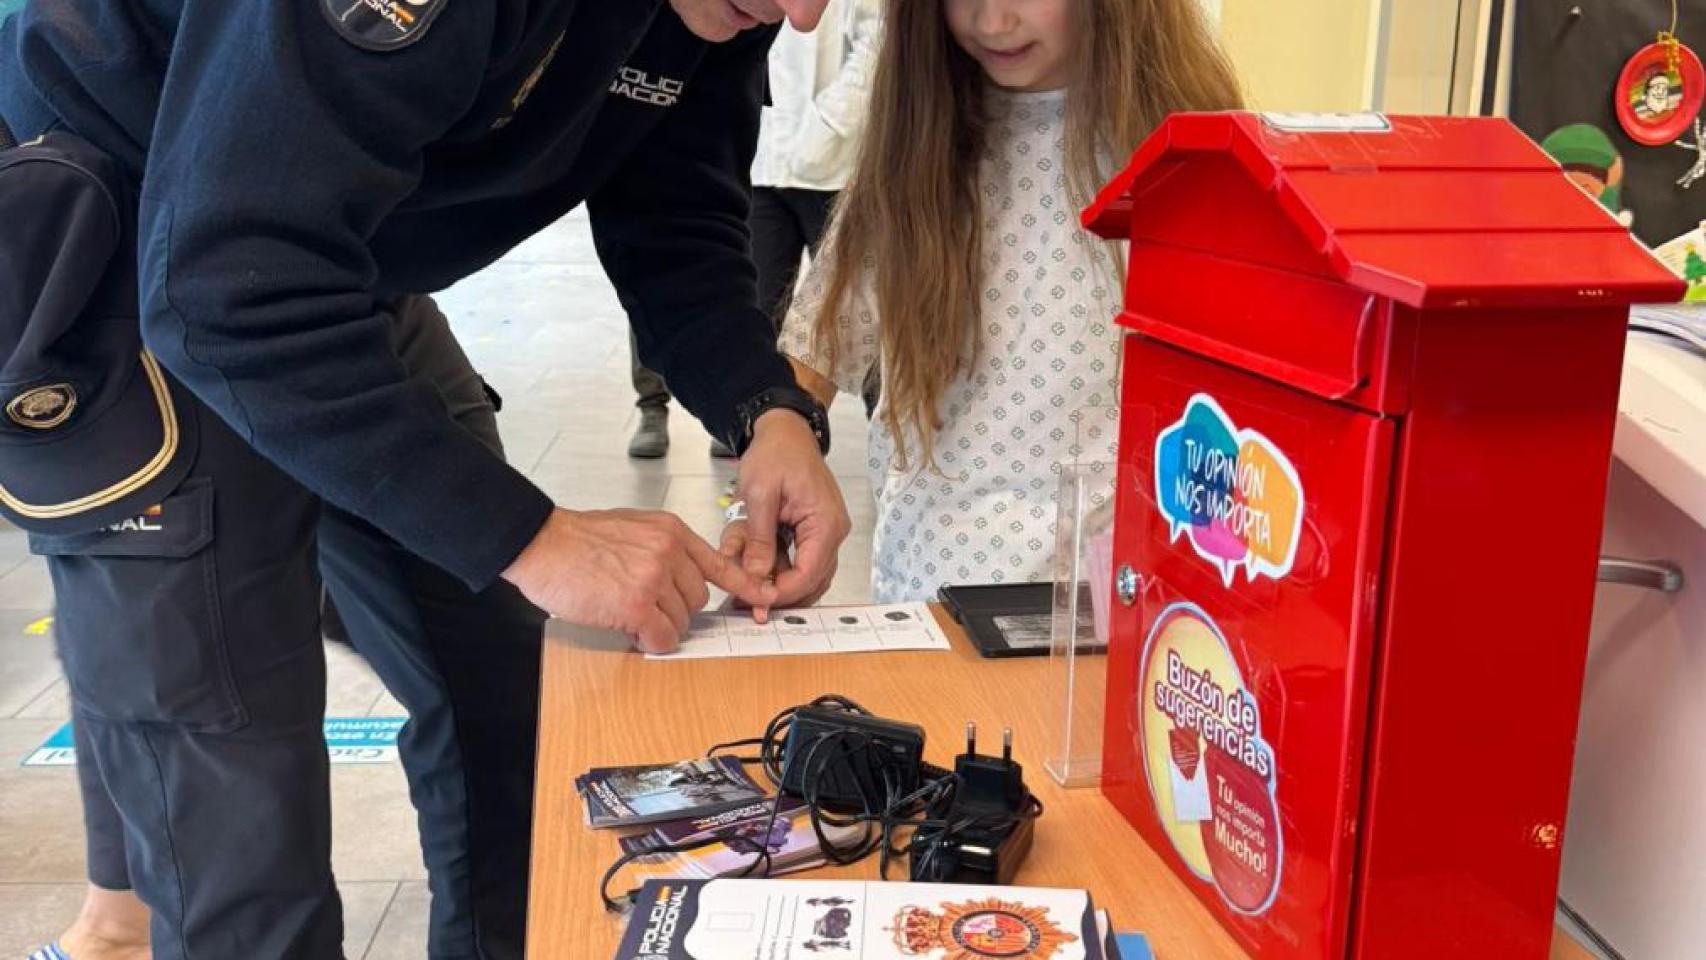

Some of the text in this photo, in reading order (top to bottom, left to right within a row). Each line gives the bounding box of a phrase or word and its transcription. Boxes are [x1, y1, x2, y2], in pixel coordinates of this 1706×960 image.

[1185, 439, 1267, 499] TU OPINIÓN
[1174, 473, 1271, 552] NOS IMPORTA
[1167, 649, 1256, 735] Buzón de
[1155, 682, 1270, 777] sugerencias
[1216, 774, 1233, 805] Tu
[1215, 816, 1267, 877] Mucho!
[1216, 804, 1265, 849] nos importa
